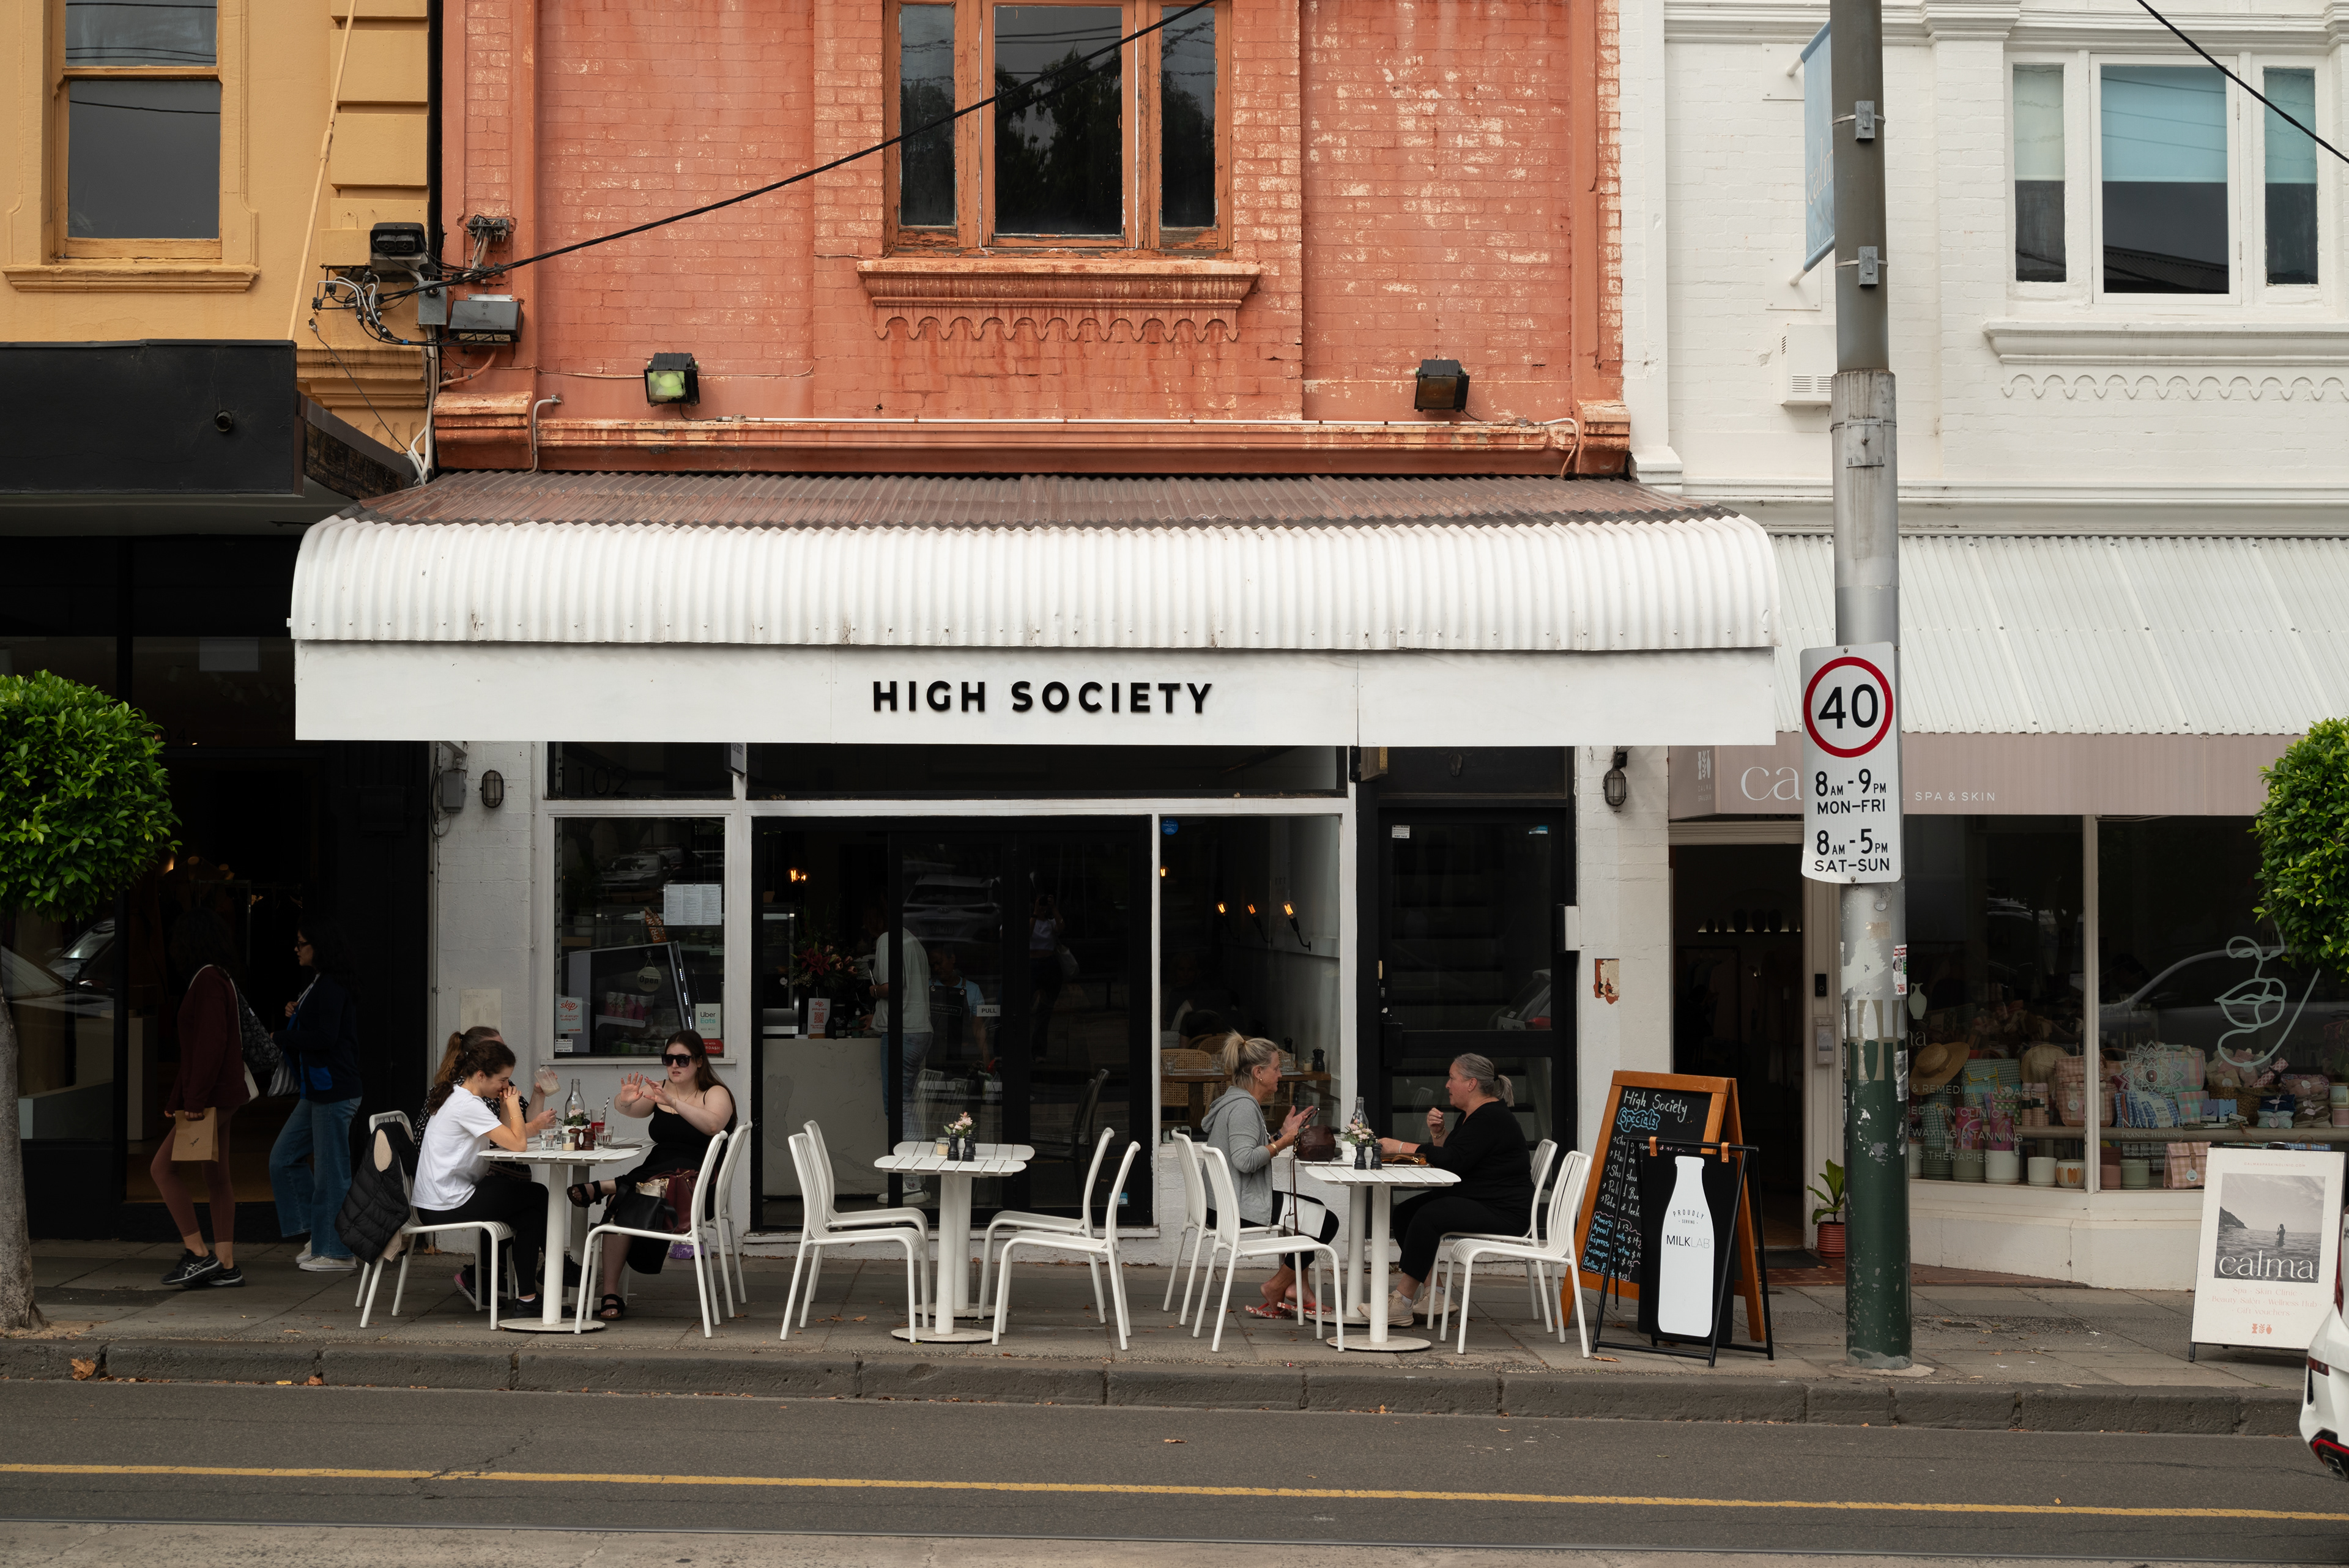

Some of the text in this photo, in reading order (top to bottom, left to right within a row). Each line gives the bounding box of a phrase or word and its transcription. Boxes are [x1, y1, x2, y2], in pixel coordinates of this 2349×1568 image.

[873, 680, 1212, 714] HIGH SOCIETY
[1818, 684, 1879, 729] 40
[557, 766, 629, 796] 1102
[1915, 792, 1995, 801] SPA & SKIN
[639, 975, 659, 985] Open
[560, 1000, 578, 1012] skip
[1623, 1090, 1688, 1123] High Society
[1930, 1106, 1956, 1117] SKIN
[1960, 1109, 2000, 1119] CLINIC
[1619, 1110, 1657, 1128] Specials
[1912, 1128, 1957, 1139] WAXING
[1972, 1131, 2024, 1143] TANNING
[1928, 1151, 1991, 1163] THERAPIES
[1608, 1180, 1628, 1197] Pulld
[1672, 1209, 1705, 1219] PROUDLY
[1592, 1223, 1609, 1236] Aperol
[1666, 1234, 1711, 1249] MILKLAB
[1583, 1256, 1599, 1271] Bellini
[2219, 1249, 2314, 1279] calma
[2276, 1288, 2298, 1296] Clinic
[2211, 1296, 2237, 1305] Beauty
[2268, 1298, 2299, 1307] Wellness
